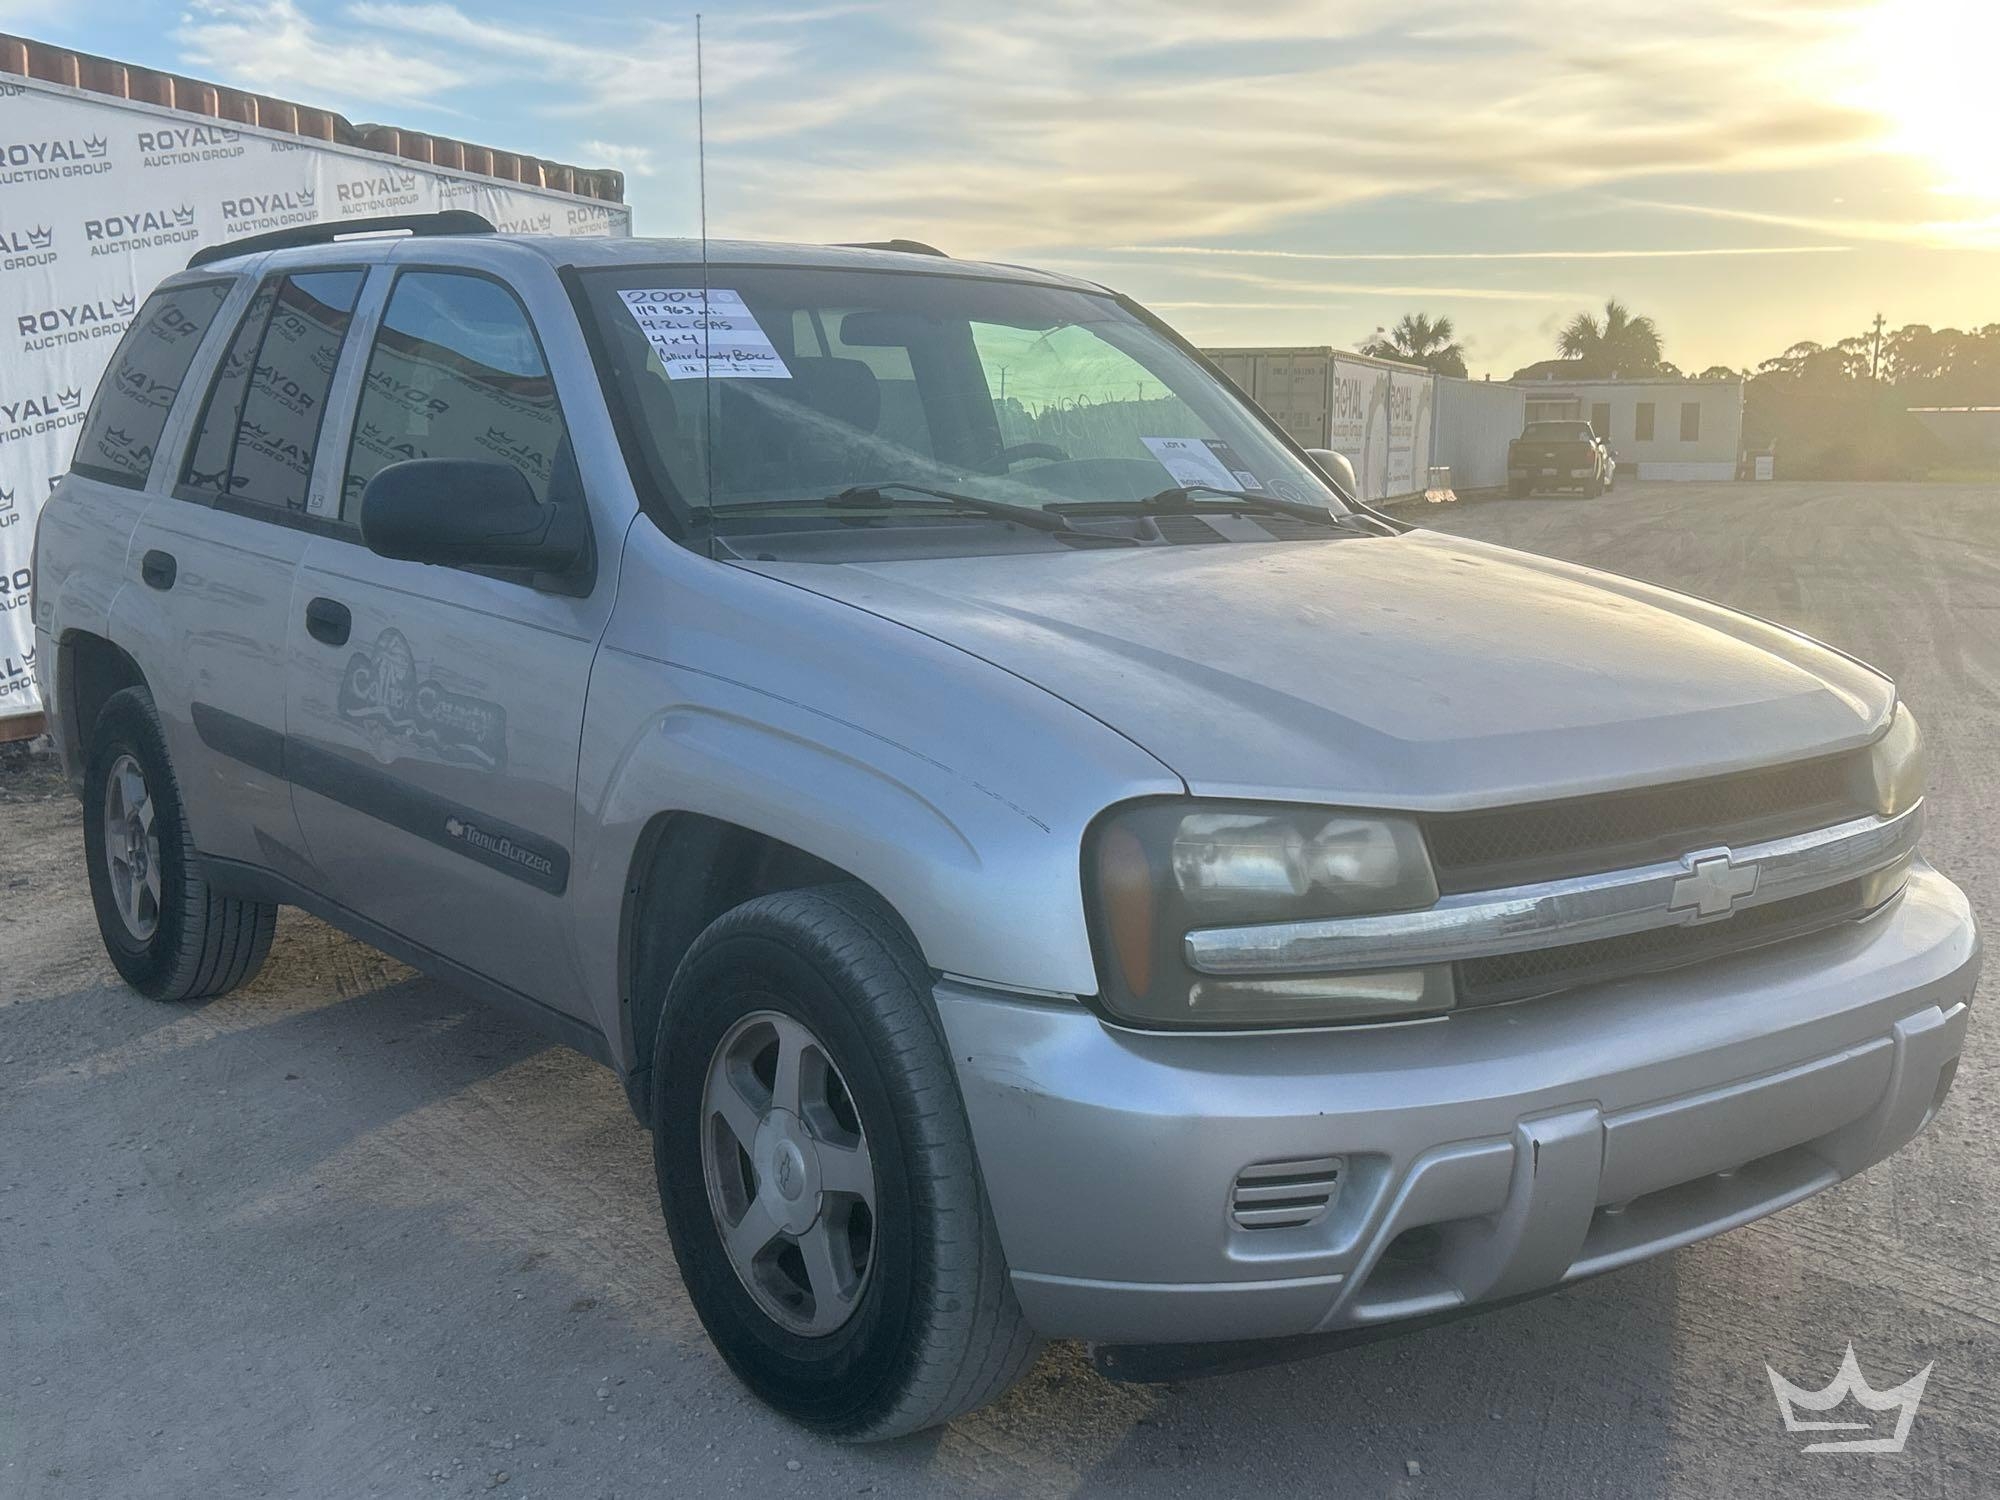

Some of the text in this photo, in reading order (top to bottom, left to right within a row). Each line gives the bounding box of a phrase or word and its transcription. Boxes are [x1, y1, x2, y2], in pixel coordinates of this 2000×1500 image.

[138, 126, 222, 153] ROYAL
[144, 146, 245, 168] AUCTION GROUP
[0, 162, 112, 184] UCTION GROUP
[338, 176, 401, 202] ROYAL
[222, 192, 298, 219] ROYAL
[342, 193, 419, 215] AUCTION GROUP
[85, 210, 174, 241] ROYAL
[227, 210, 319, 234] AUCTION GROUP
[91, 229, 199, 257] AUCTION GROUP
[4, 252, 58, 271] GROUP
[627, 291, 709, 304] 2004
[18, 301, 114, 337] ROYAL
[693, 320, 732, 331] GAS
[24, 329, 89, 353] AUCTION
[91, 320, 132, 339] GROU
[2, 395, 59, 424] YAL
[1334, 376, 1363, 420] ROYAL
[1162, 441, 1180, 449] LOT
